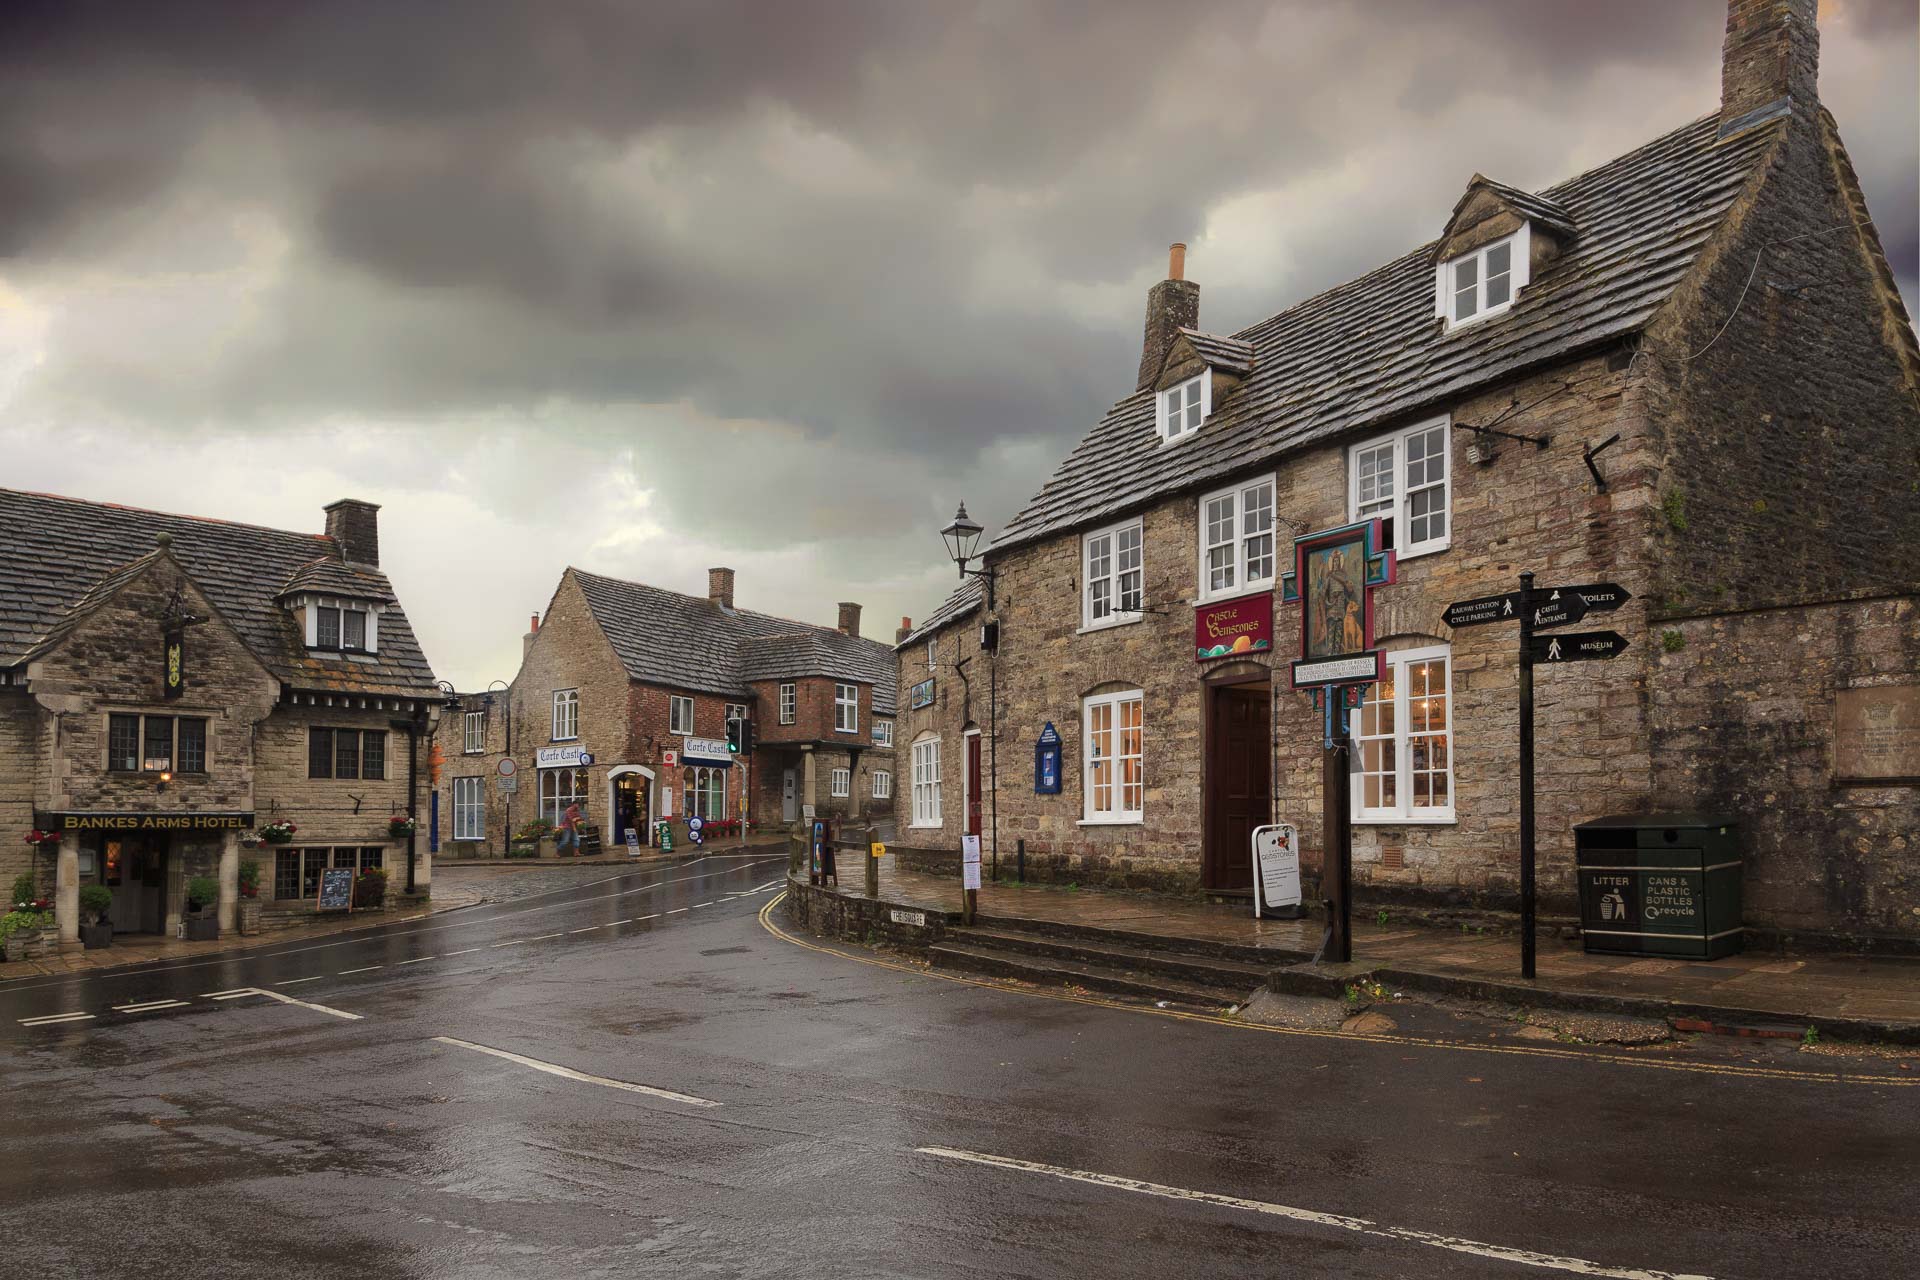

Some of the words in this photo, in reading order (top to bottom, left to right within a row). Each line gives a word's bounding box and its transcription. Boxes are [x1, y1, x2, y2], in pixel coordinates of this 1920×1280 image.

[1583, 593, 1615, 602] TOILETS
[1475, 601, 1500, 611] STATION
[1541, 604, 1559, 613] CASTLE
[1451, 615, 1470, 624] CYCLE
[1470, 611, 1497, 621] PARKING
[1540, 613, 1567, 624] ENTRANCE
[1580, 641, 1613, 650] MUSEUM
[686, 739, 706, 752] Corfe
[540, 750, 559, 761] Corfe
[64, 816, 138, 828] BANKES
[141, 816, 191, 828] ARMS
[195, 816, 247, 828] HOTEL
[1593, 877, 1629, 885] LITTER
[1648, 877, 1677, 885] CANS
[1647, 887, 1690, 895] PLASTIC
[1646, 896, 1692, 905] BOTTLES
[893, 911, 903, 921] THE
[1659, 906, 1695, 916] recycle
